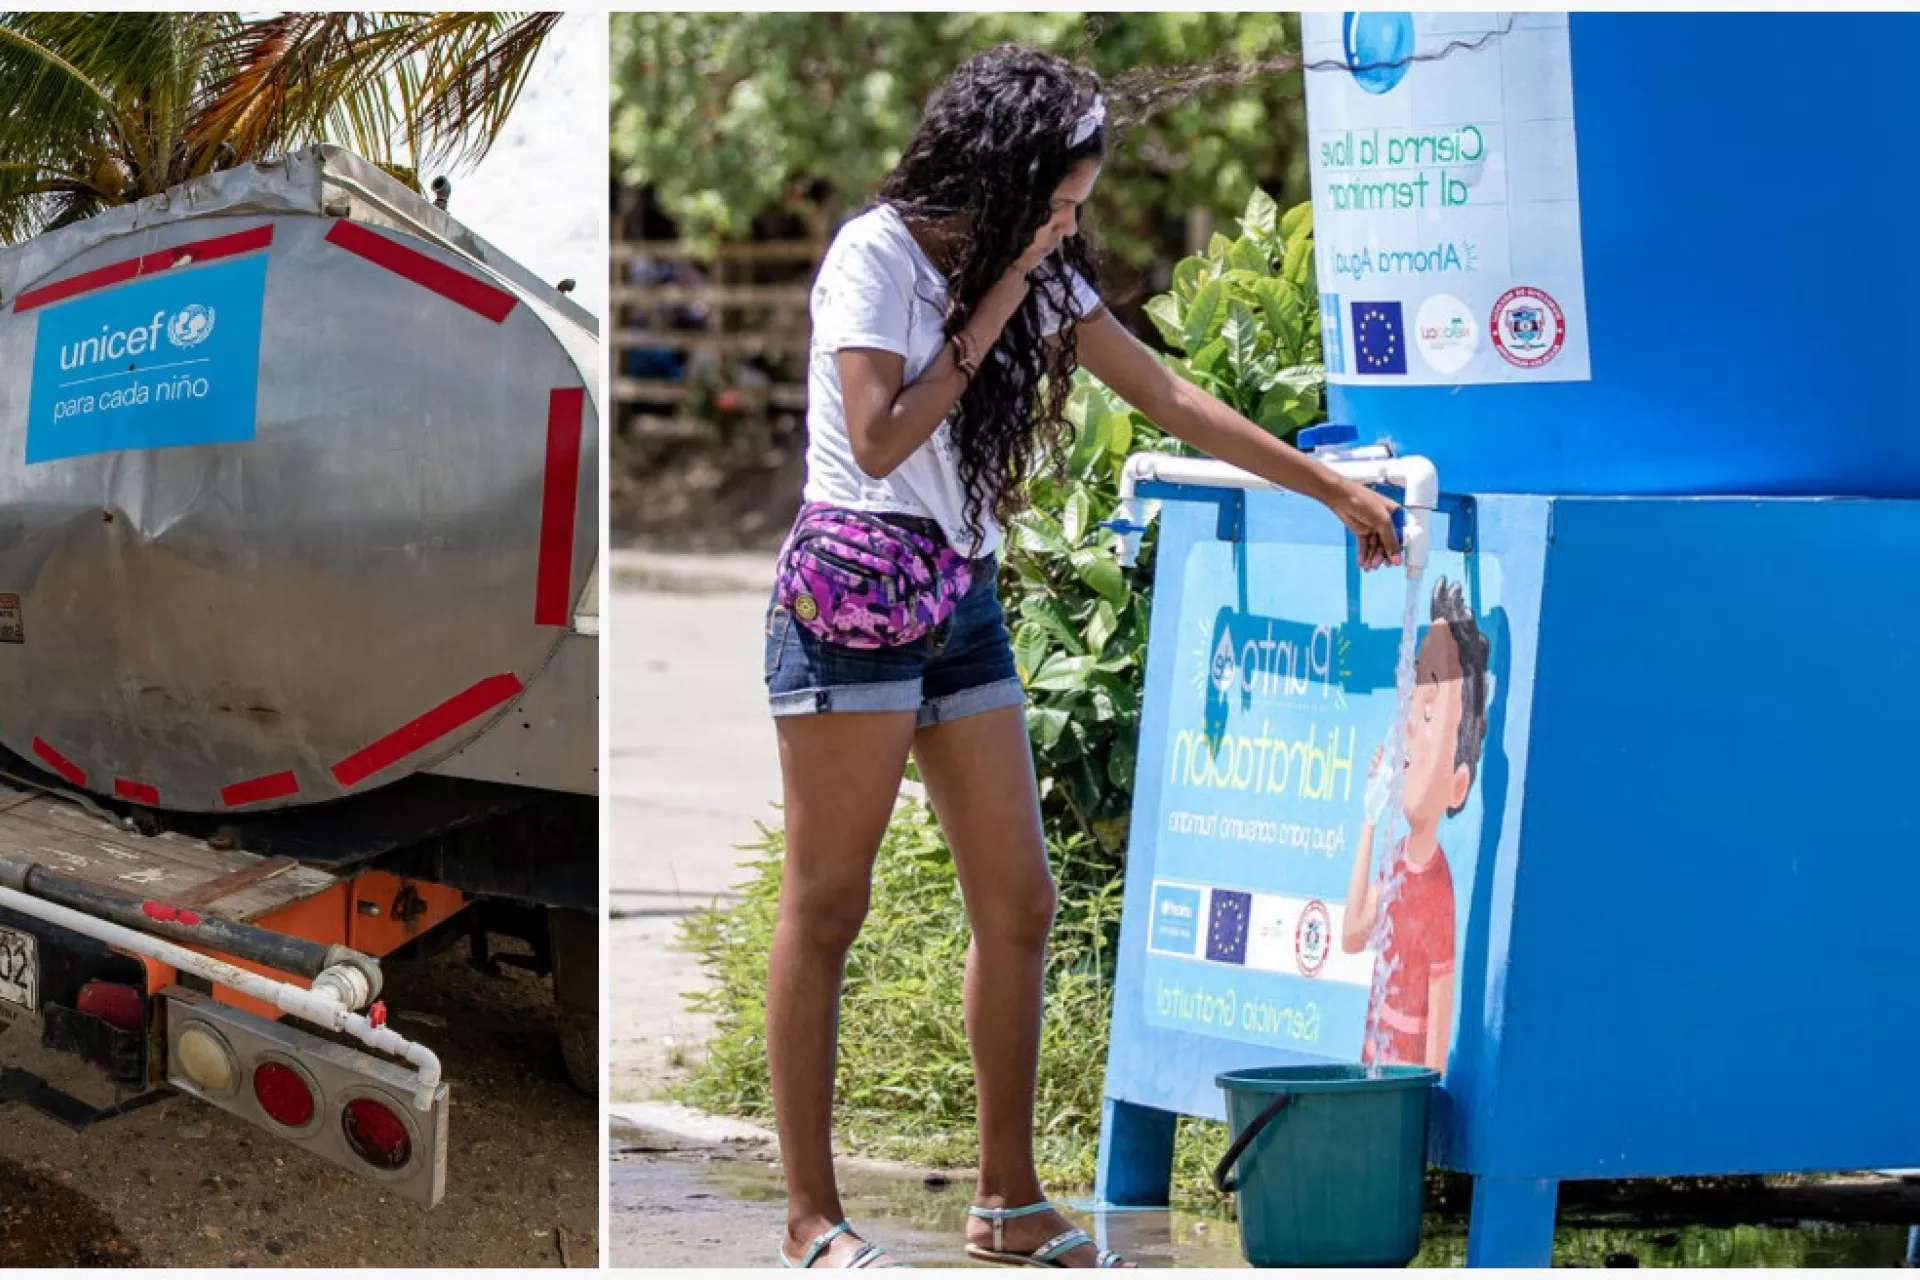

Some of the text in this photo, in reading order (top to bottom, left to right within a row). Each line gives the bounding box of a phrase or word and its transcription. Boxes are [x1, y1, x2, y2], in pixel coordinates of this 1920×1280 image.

[60, 312, 165, 370] unicef
[54, 375, 209, 425] para cada niño
